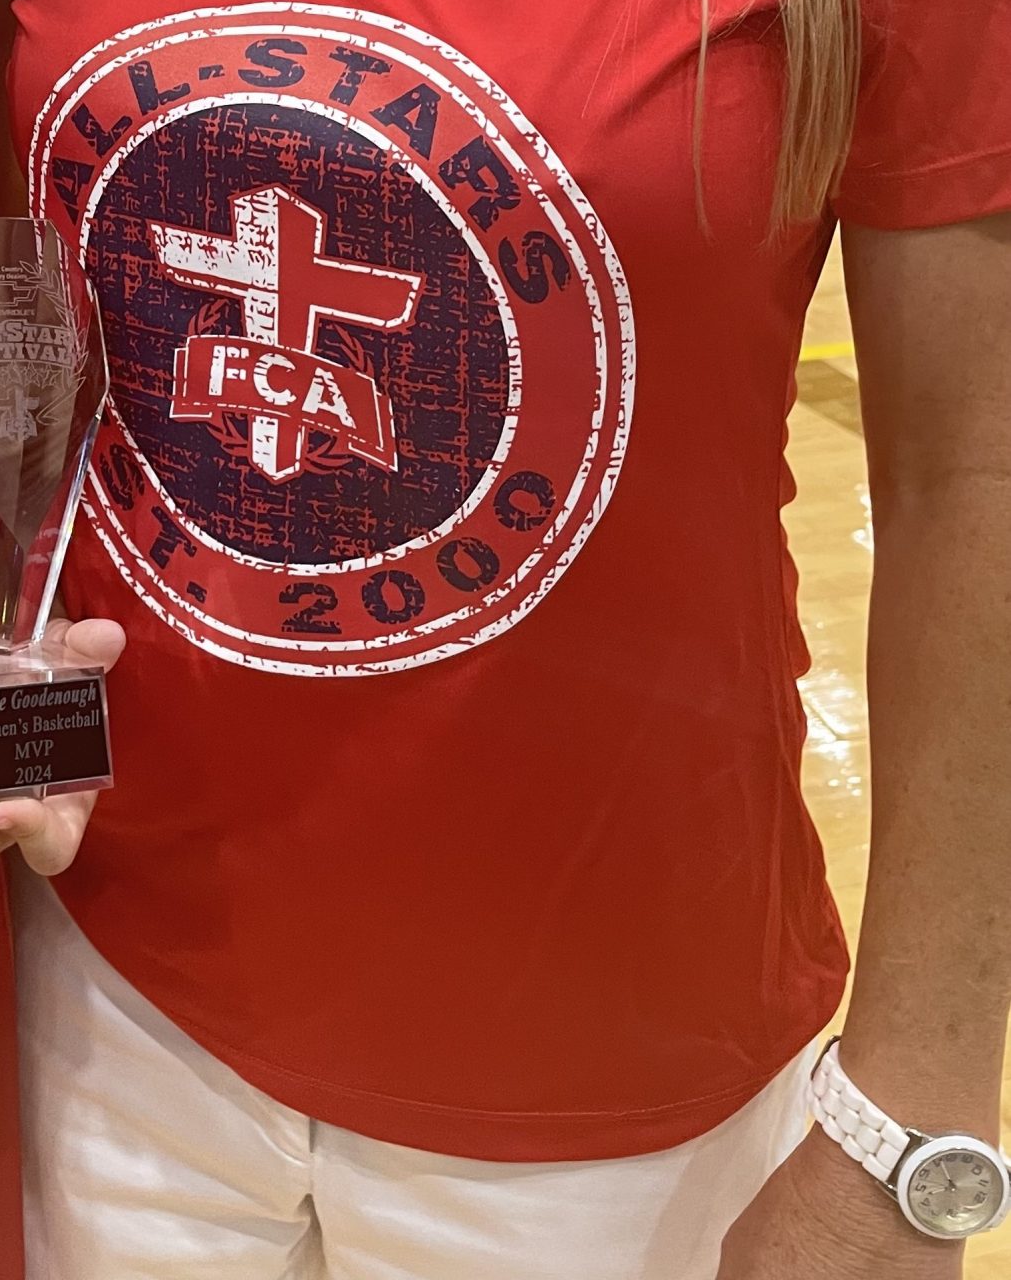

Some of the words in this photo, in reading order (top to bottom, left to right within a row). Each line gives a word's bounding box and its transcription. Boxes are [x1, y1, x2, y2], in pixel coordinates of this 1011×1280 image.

[52, 38, 571, 305] ALL-STARS
[207, 344, 357, 431] FCA
[98, 417, 207, 604] ST.
[281, 472, 556, 634] 2000
[11, 681, 97, 708] Goodenough
[33, 709, 100, 735] Basketball
[14, 739, 54, 761] MVP
[15, 764, 53, 785] 2024
